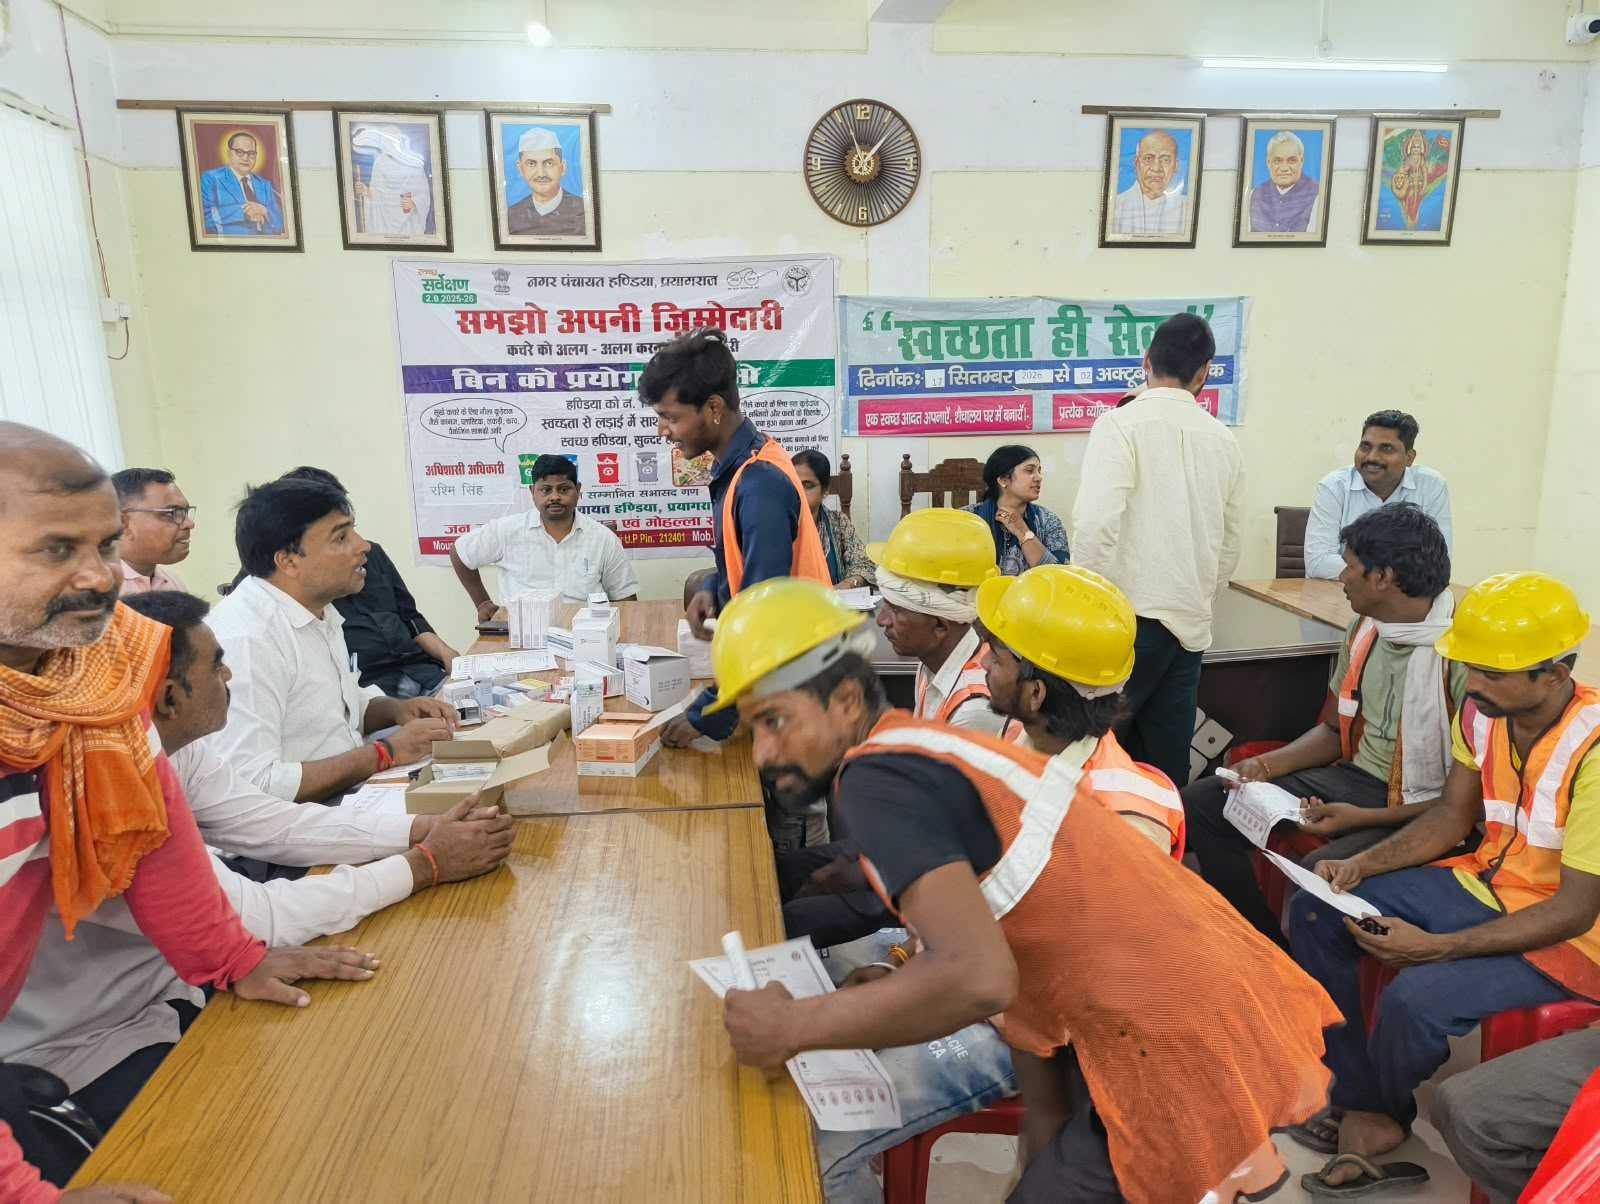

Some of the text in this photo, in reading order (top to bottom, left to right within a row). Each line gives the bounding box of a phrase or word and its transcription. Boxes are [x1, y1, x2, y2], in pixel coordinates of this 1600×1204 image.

[856, 105, 871, 120] 12
[421, 274, 470, 292] सर्वेक्षण
[527, 275, 556, 288] नगर
[561, 273, 604, 288] पंचायत
[660, 274, 718, 288] प्रयागराज
[425, 294, 439, 303] 2.0
[455, 302, 548, 335] समझो
[557, 302, 642, 334] अपनी
[1048, 304, 1092, 357] ही
[506, 341, 534, 356] कचरे
[538, 341, 552, 356] को
[556, 343, 588, 356] अलग
[601, 342, 631, 355] अलग
[452, 368, 508, 390] बिन
[517, 367, 557, 389] को
[948, 365, 1014, 385] सितम्बर
[1054, 363, 1070, 383] से
[566, 397, 601, 410] हण्डिया
[605, 396, 619, 409] को
[1059, 401, 1084, 420] प्रत्येक
[582, 416, 592, 428] से
[595, 415, 623, 429] लड़ाई
[627, 414, 636, 427] में
[865, 413, 878, 427] एक
[901, 412, 922, 425] आदत
[560, 437, 588, 447] स्वच्छ
[468, 461, 505, 475] अधिकारी
[646, 516, 700, 527] मोहल्ला
[659, 533, 686, 543] 212401
[692, 531, 714, 542] Mob.
